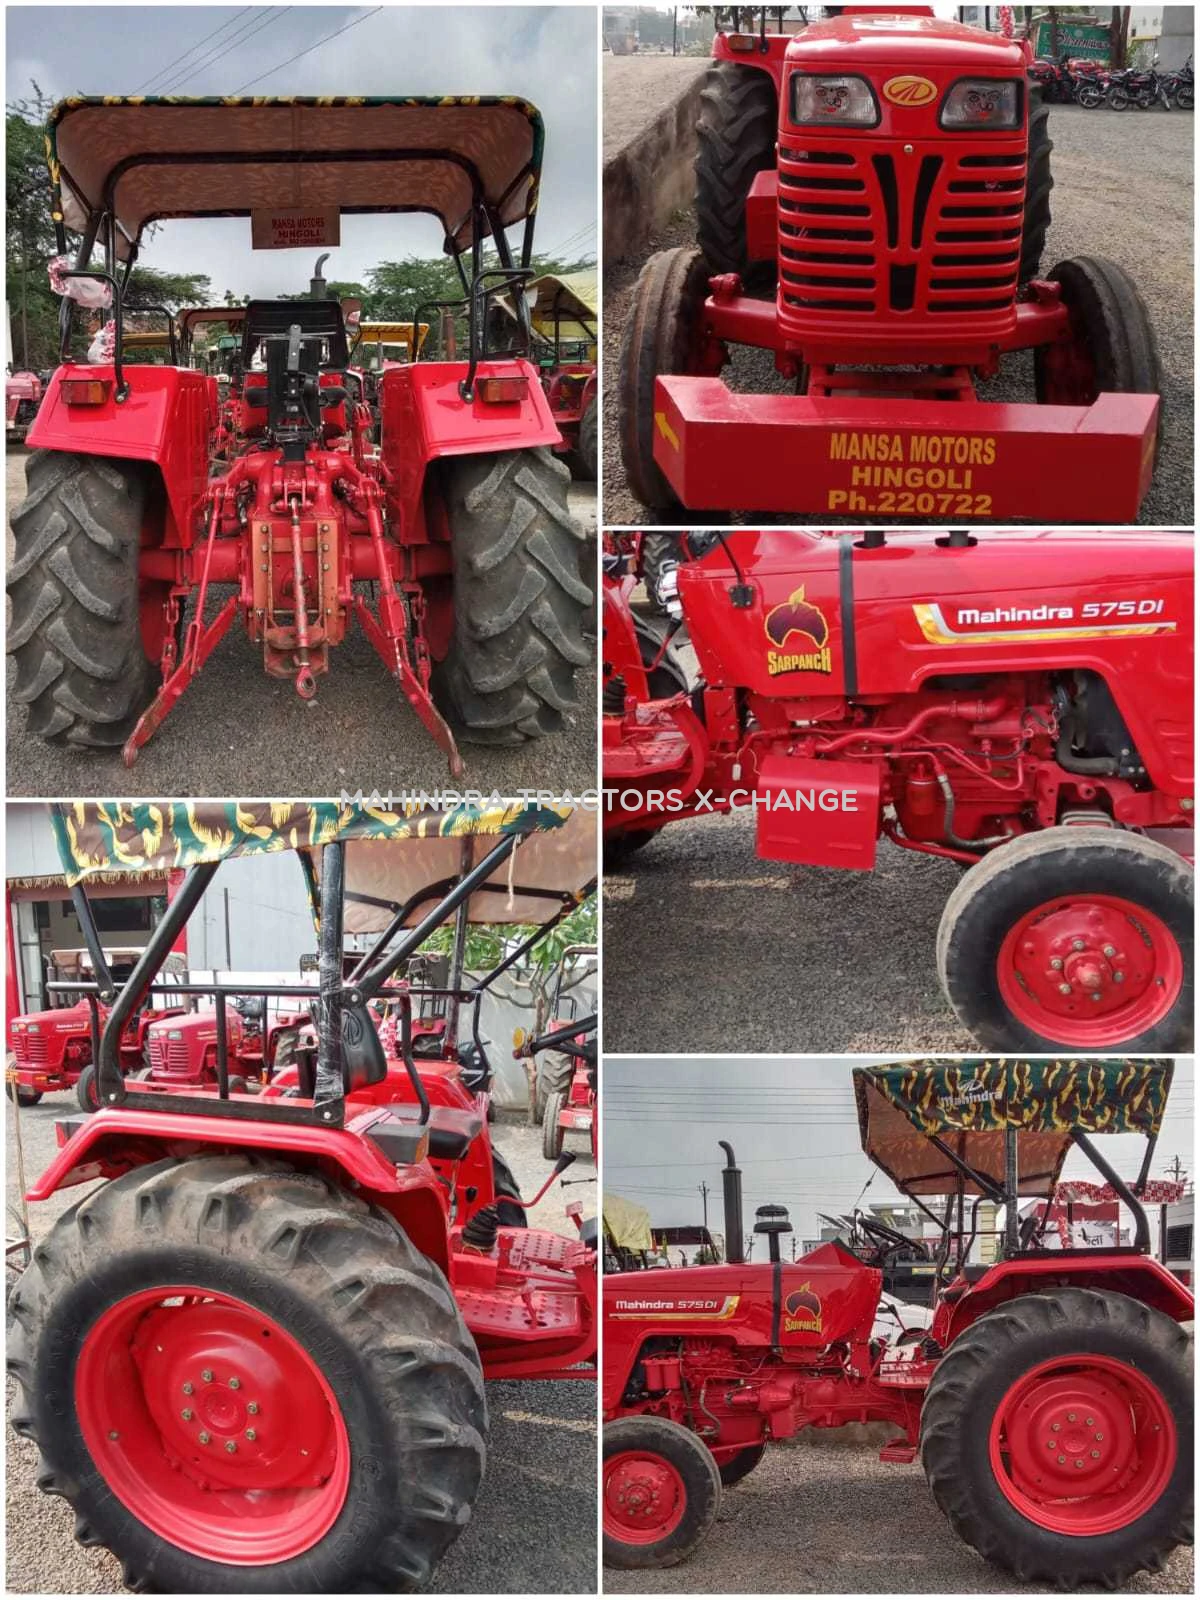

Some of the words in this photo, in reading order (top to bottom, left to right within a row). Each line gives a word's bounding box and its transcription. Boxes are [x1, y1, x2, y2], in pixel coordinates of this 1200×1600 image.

[278, 229, 320, 239] HINGOLI
[830, 432, 903, 462] MANSA
[910, 435, 996, 465] MOTORS
[852, 465, 972, 489] HINGOLI
[828, 490, 992, 515] Ph.220722
[958, 605, 1073, 624] Mahindra
[767, 648, 832, 675] SARPANCH
[615, 1300, 674, 1309] Mahindra
